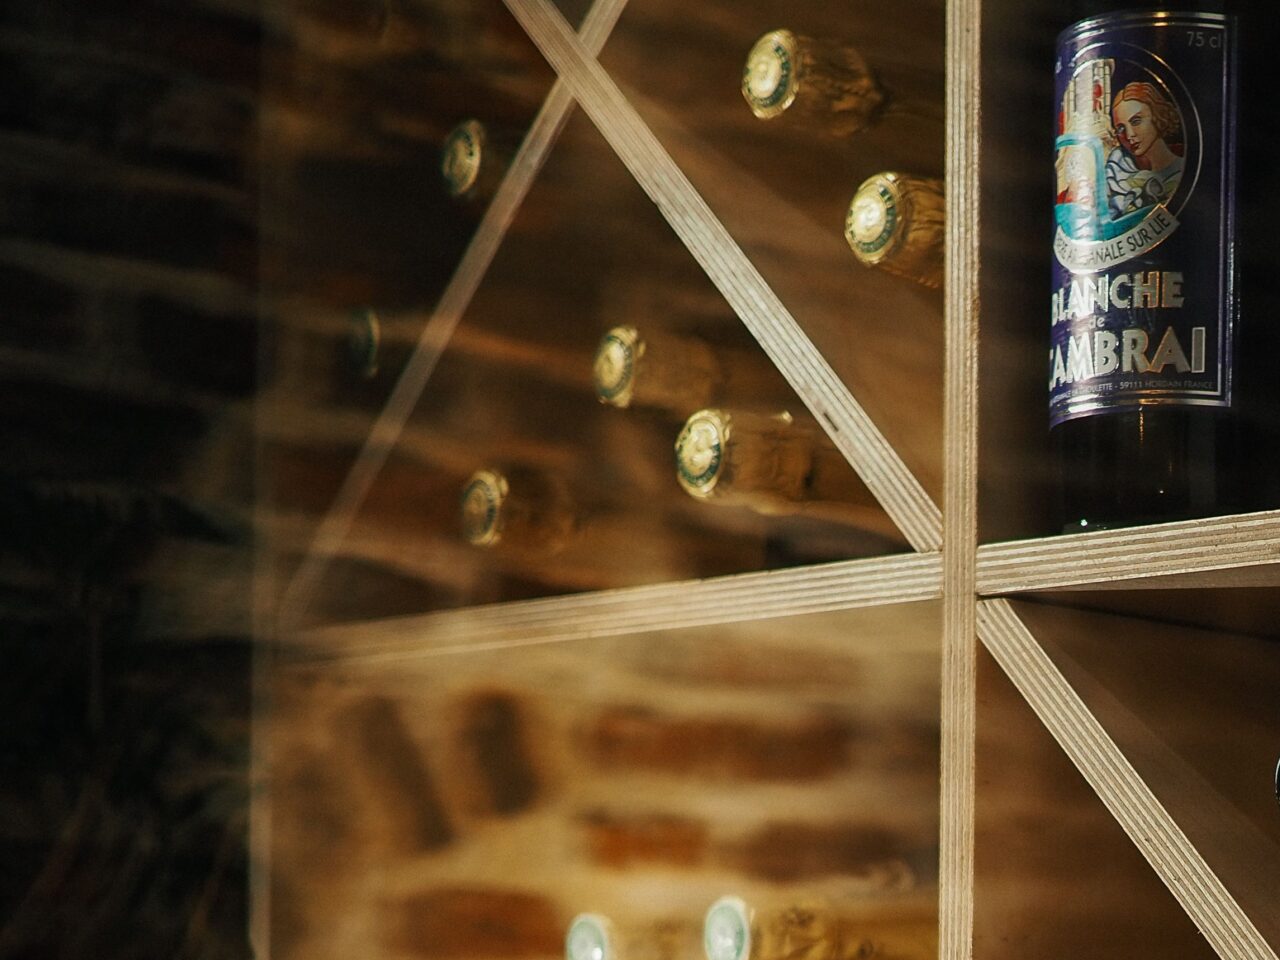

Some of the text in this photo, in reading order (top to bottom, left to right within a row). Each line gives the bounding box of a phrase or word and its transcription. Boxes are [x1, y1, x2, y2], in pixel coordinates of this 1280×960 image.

[1186, 31, 1205, 48] 75
[1126, 228, 1153, 252] SUR
[1150, 212, 1171, 236] LIE
